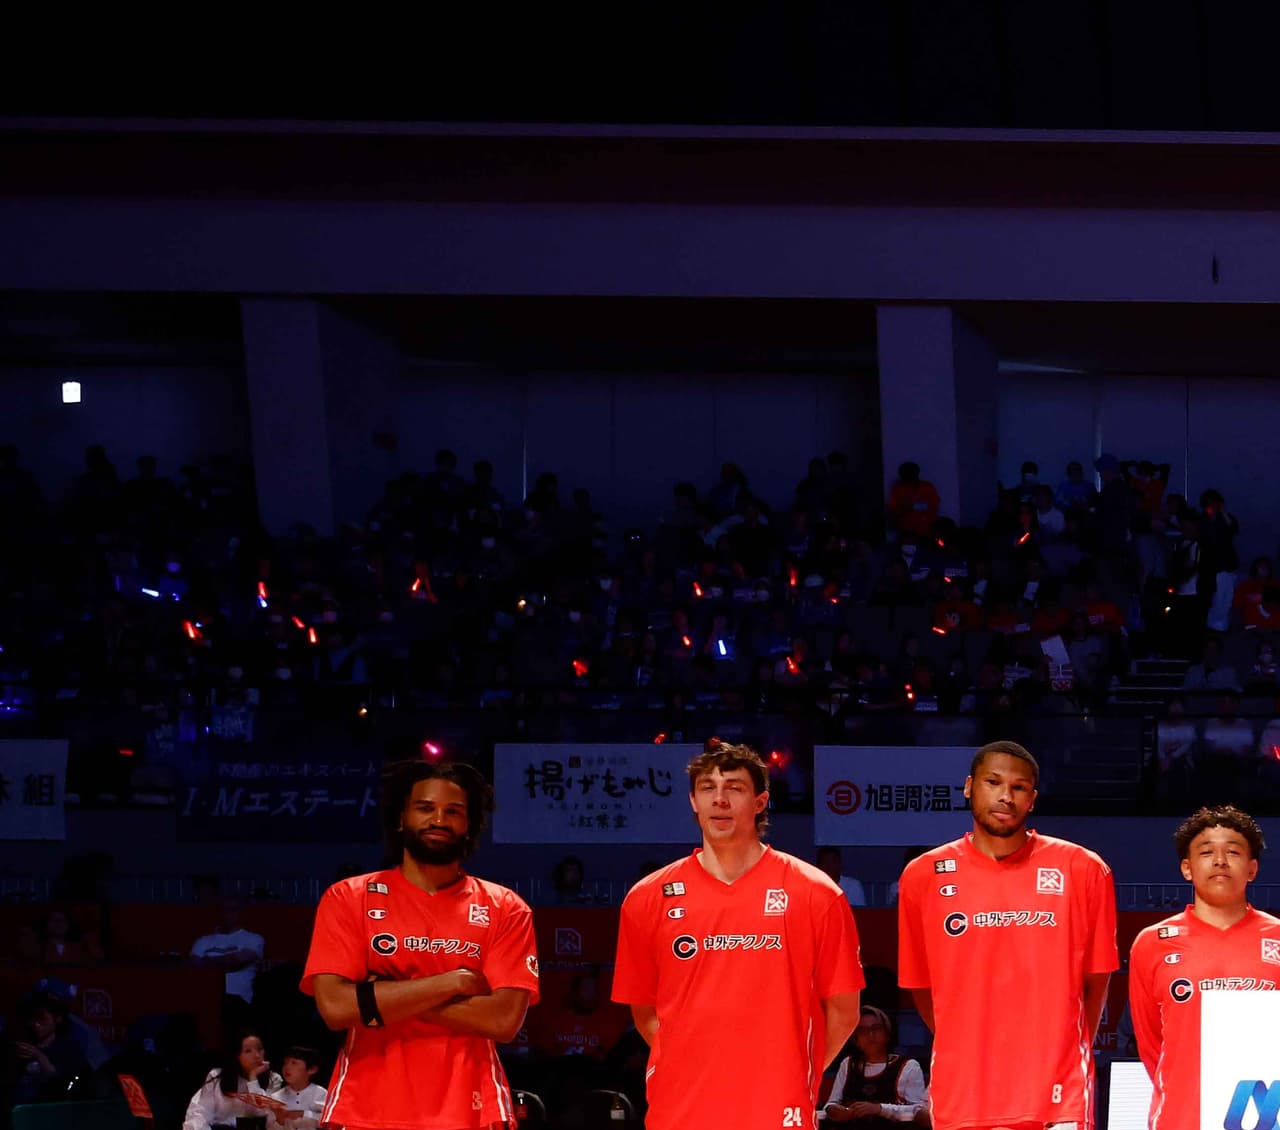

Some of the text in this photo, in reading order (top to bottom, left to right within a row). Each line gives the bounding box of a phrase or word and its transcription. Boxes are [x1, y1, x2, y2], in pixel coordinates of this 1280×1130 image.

[974, 912, 1056, 926] 中外テクノス
[404, 936, 481, 959] 中外テクノス
[703, 935, 782, 950] 中外テクノス
[1051, 1084, 1062, 1103] 8
[782, 1107, 802, 1127] 24
